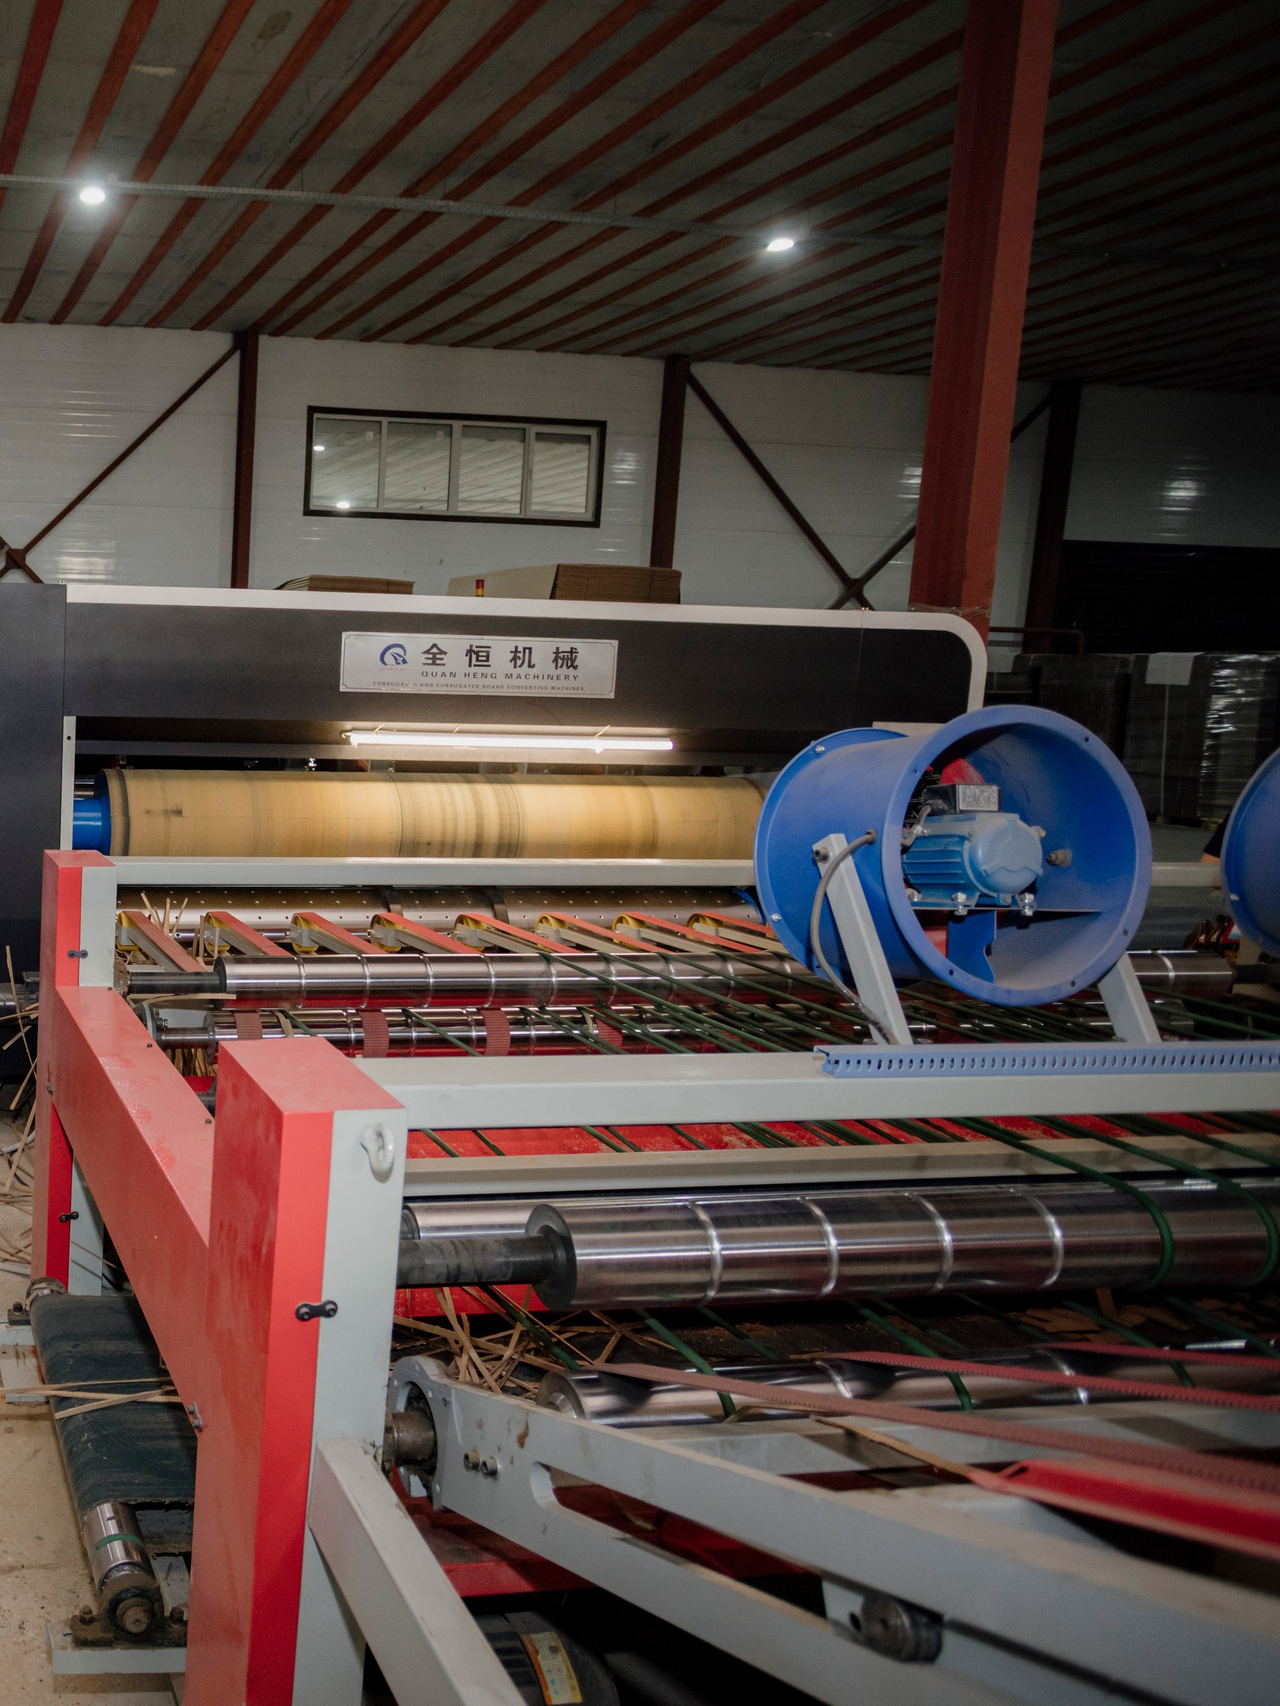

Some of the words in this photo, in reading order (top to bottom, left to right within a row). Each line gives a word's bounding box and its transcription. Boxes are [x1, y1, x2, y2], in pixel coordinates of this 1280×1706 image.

[421, 642, 579, 671] 全恒机械
[504, 673, 579, 681] MACHINERY
